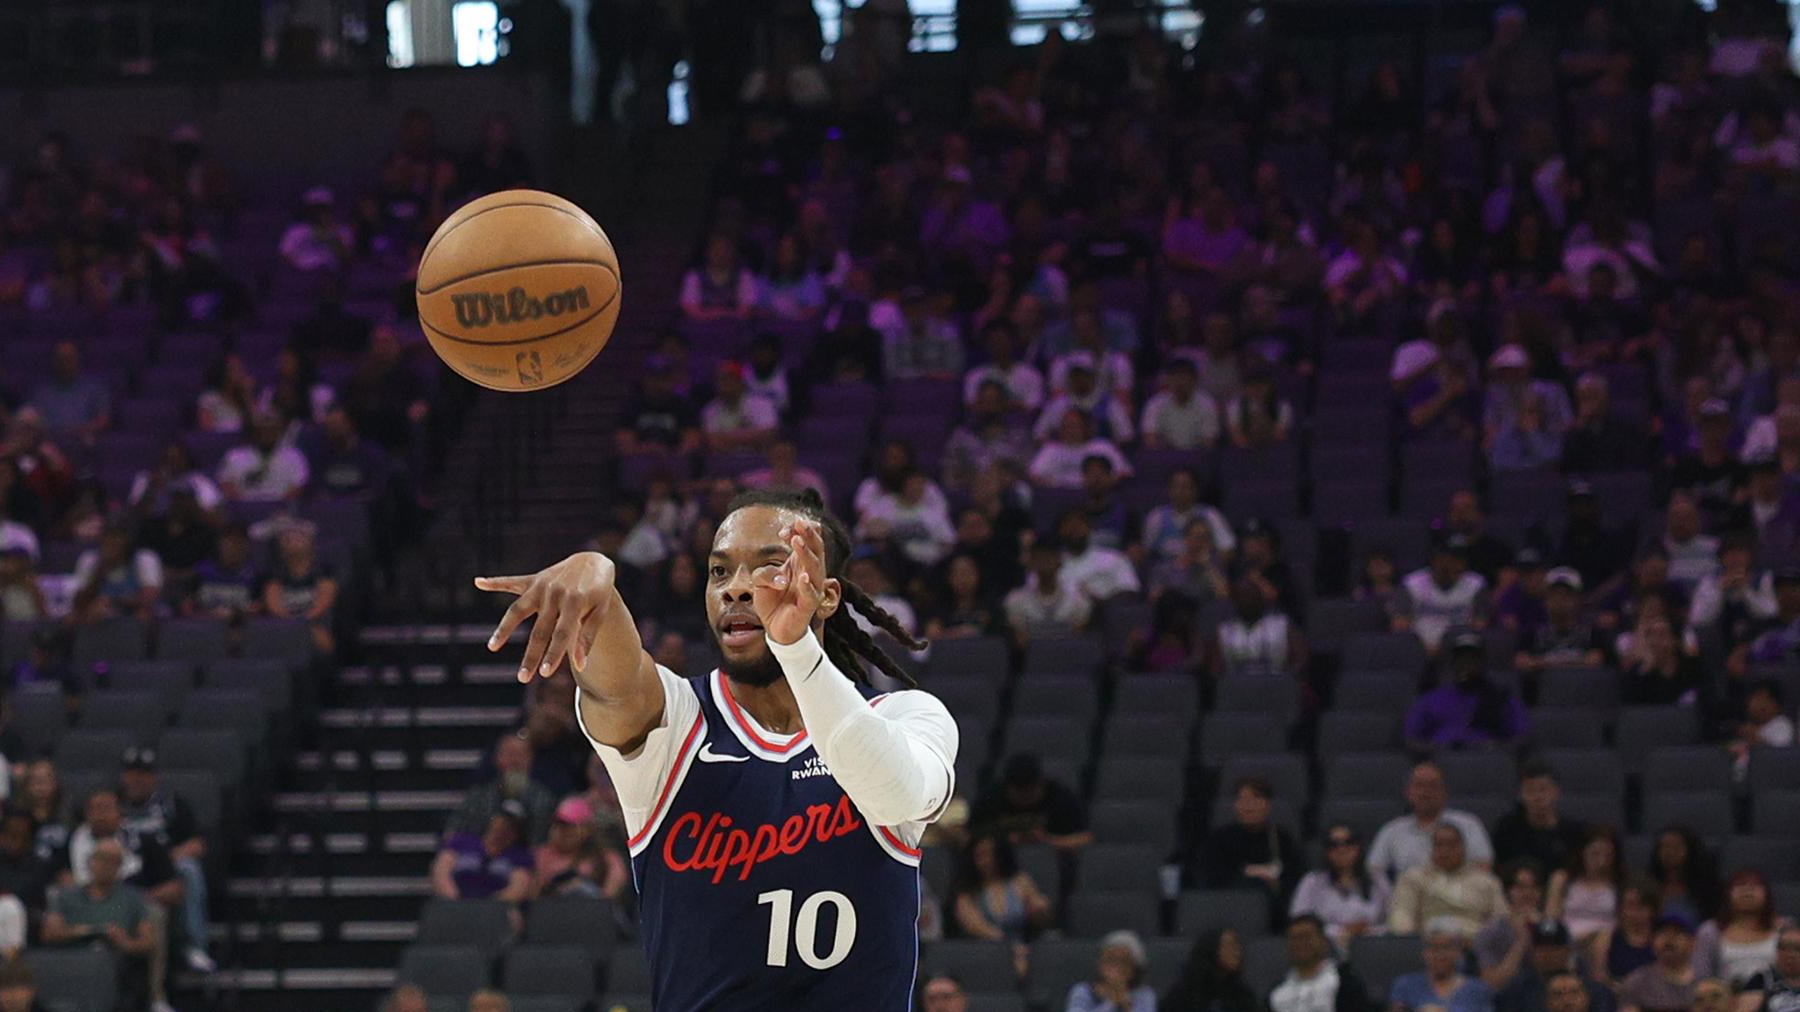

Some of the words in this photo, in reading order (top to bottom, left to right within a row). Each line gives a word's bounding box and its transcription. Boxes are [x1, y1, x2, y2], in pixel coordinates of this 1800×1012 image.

[451, 285, 591, 330] Wilson
[663, 794, 861, 885] Clippers
[757, 889, 857, 970] 10
